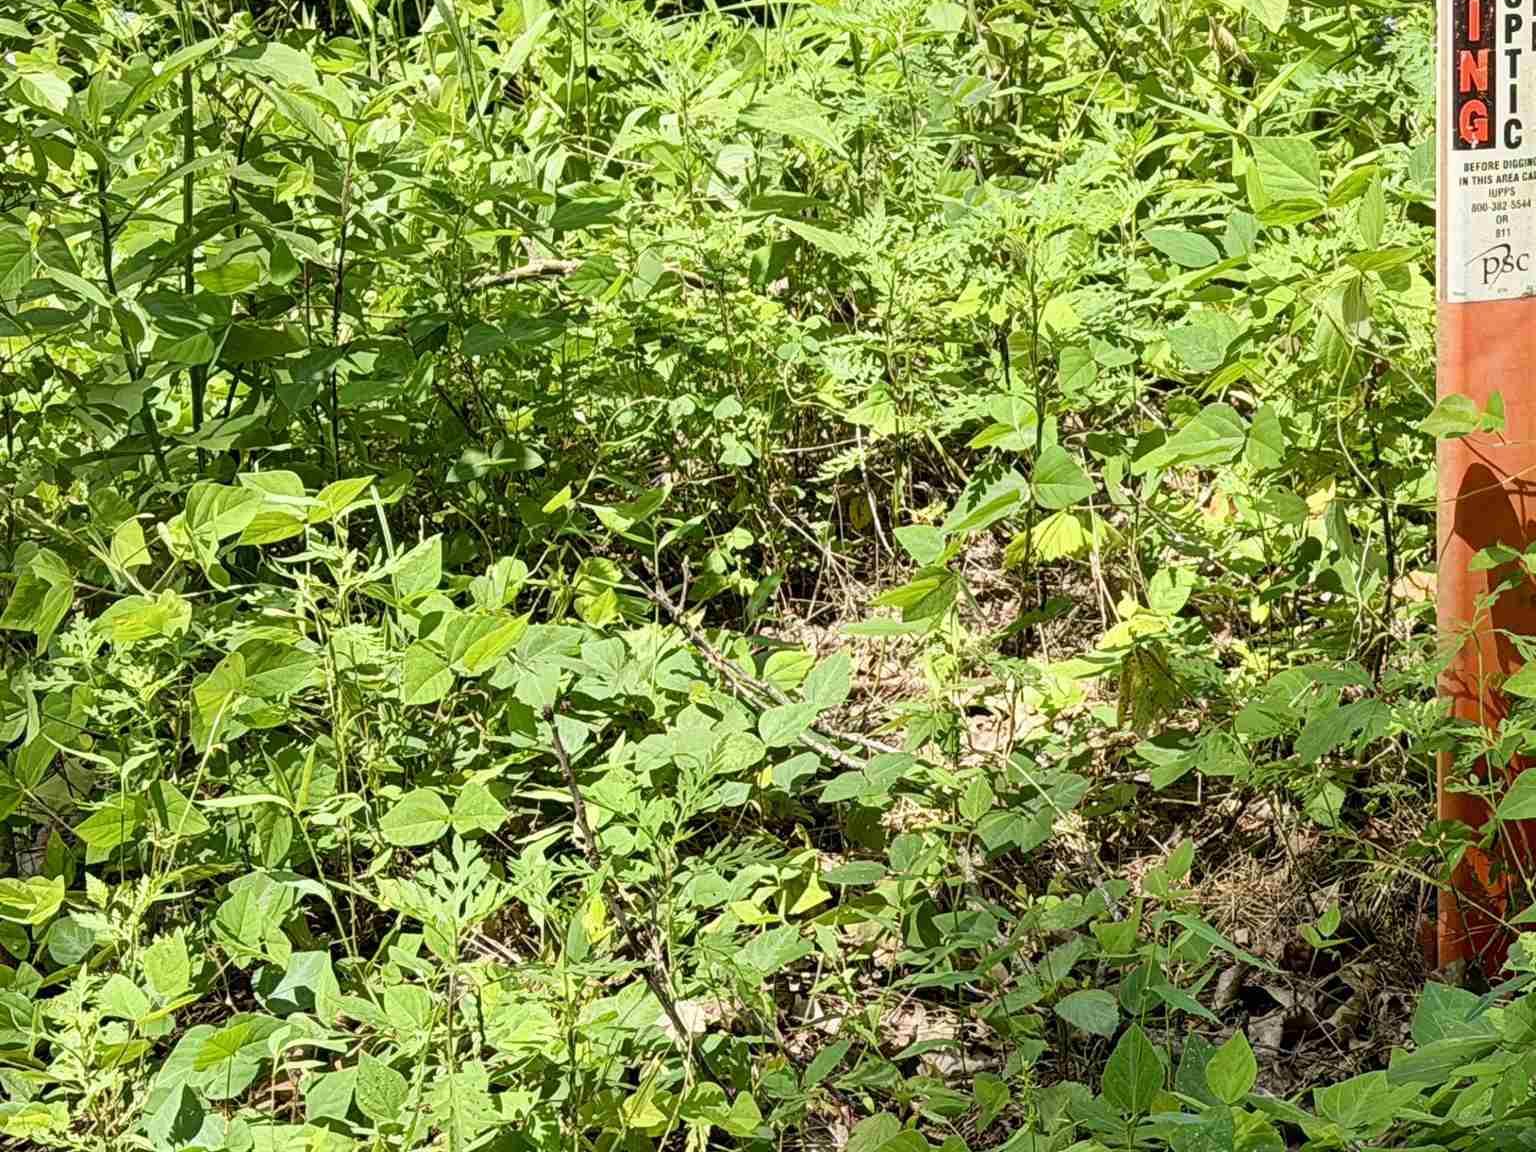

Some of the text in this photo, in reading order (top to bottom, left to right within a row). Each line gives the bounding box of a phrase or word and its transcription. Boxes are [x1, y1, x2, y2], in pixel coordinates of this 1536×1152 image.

[1463, 160, 1500, 172] BEFORE
[1458, 176, 1469, 186] IN
[1472, 174, 1494, 186] THIS
[1495, 172, 1520, 184] AREA
[1495, 214, 1509, 225] OR
